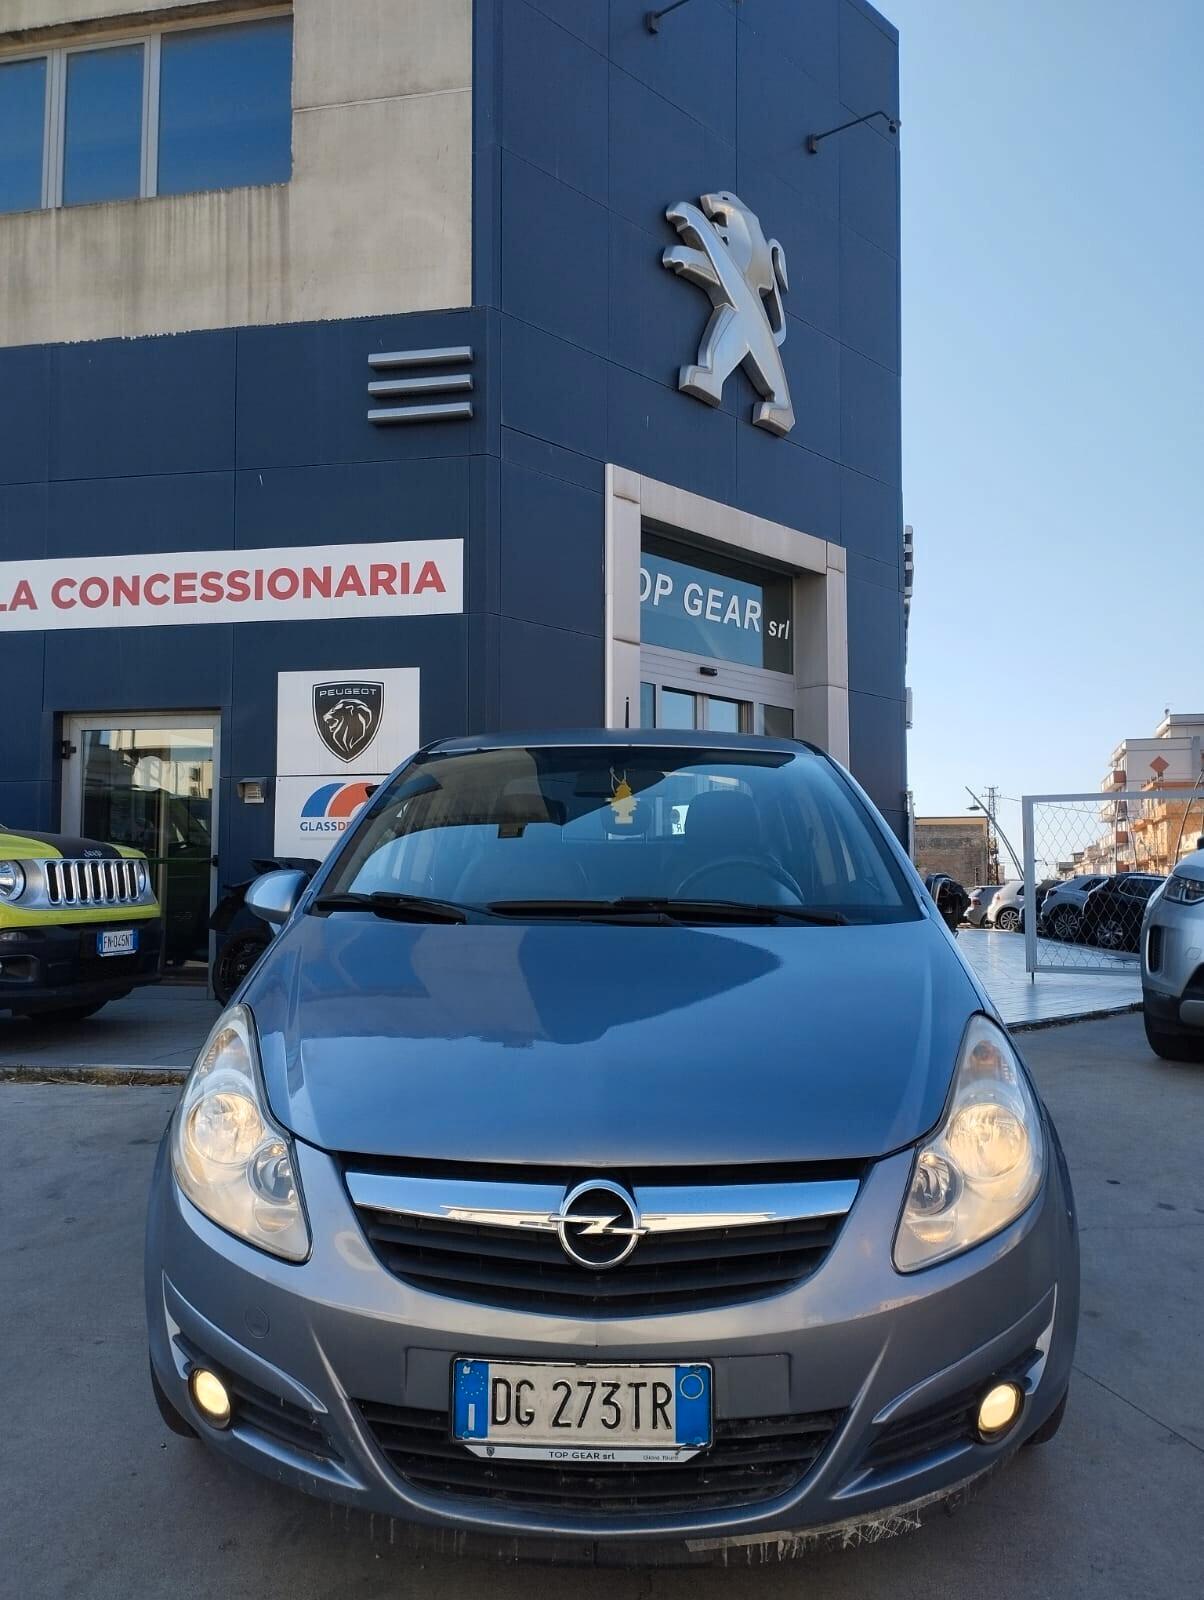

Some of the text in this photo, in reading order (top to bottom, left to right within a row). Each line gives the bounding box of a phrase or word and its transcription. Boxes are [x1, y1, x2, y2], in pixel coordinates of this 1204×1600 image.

[51, 560, 446, 610] CONCESSIONARIA
[684, 583, 761, 632] GEAR
[768, 620, 790, 639] srl
[319, 688, 377, 697] PEUGEOT
[492, 1377, 535, 1427] DG
[551, 1381, 672, 1430] 273TR
[549, 1451, 615, 1460] TOP GEAR srl
